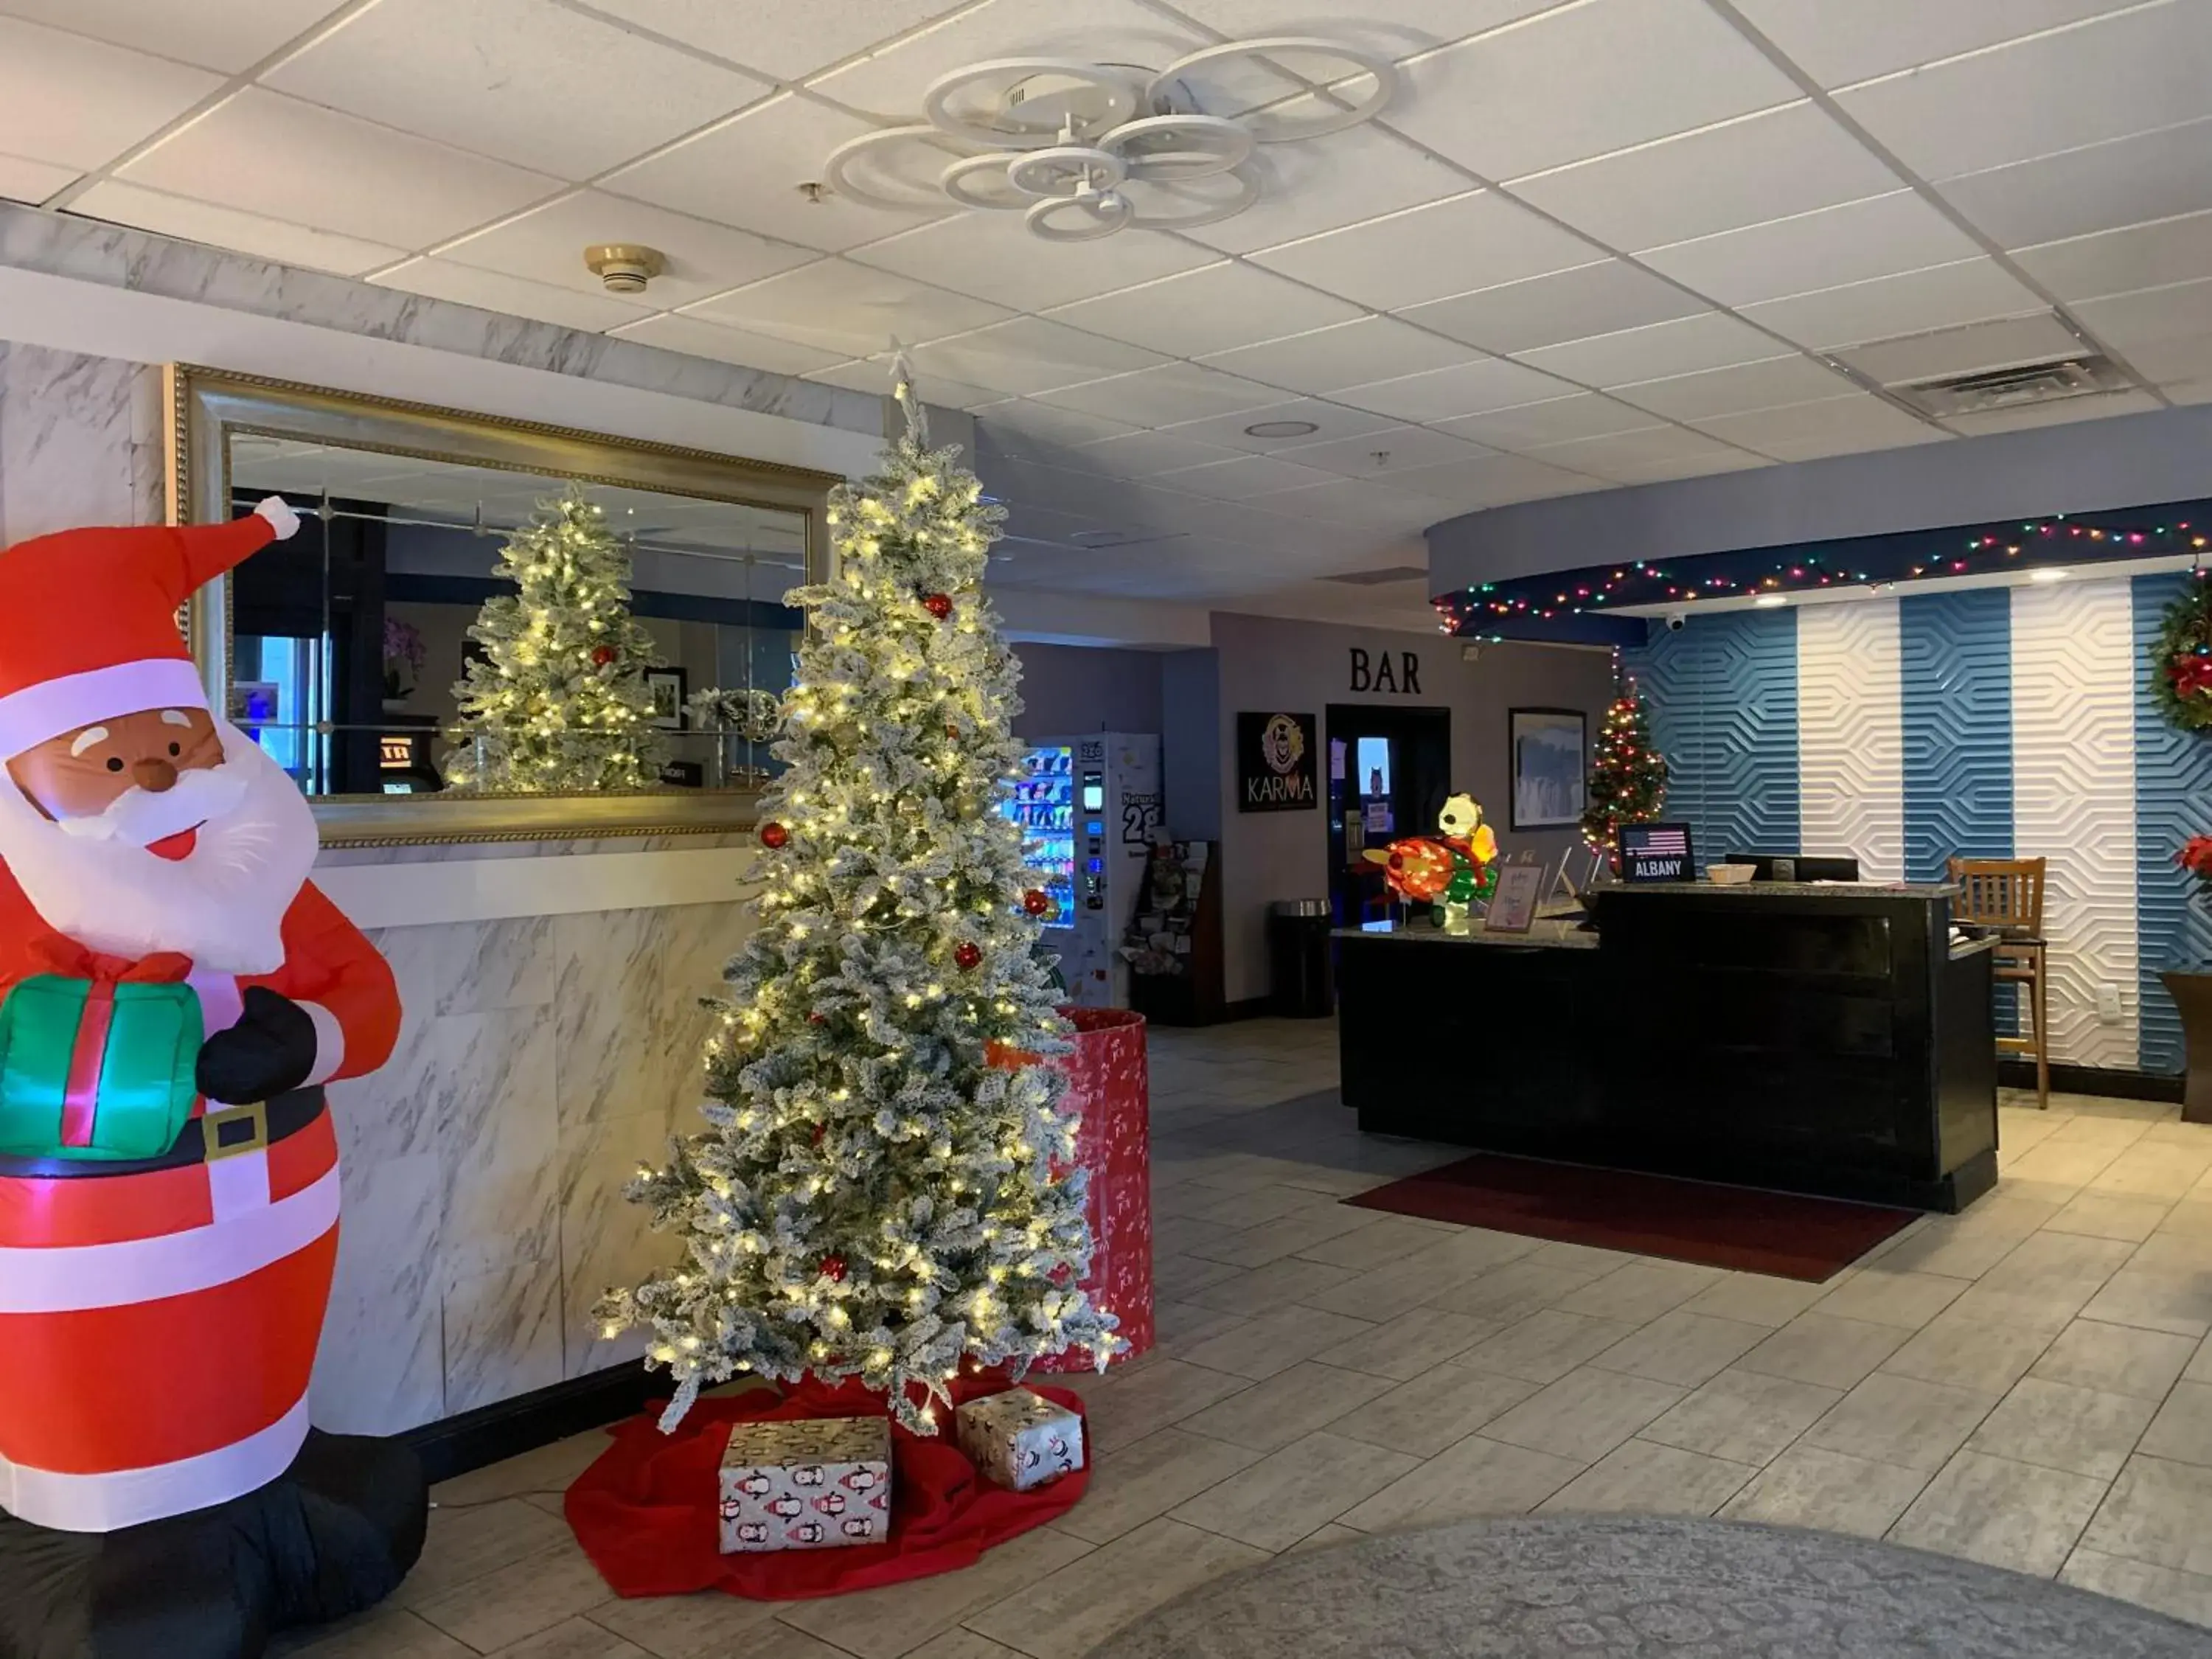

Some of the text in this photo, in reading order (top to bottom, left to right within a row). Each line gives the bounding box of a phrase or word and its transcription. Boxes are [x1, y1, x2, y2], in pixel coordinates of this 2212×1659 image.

[1349, 648, 1422, 694] BAR
[1248, 773, 1313, 802] KARMA
[1635, 860, 1681, 877] ALBANY
